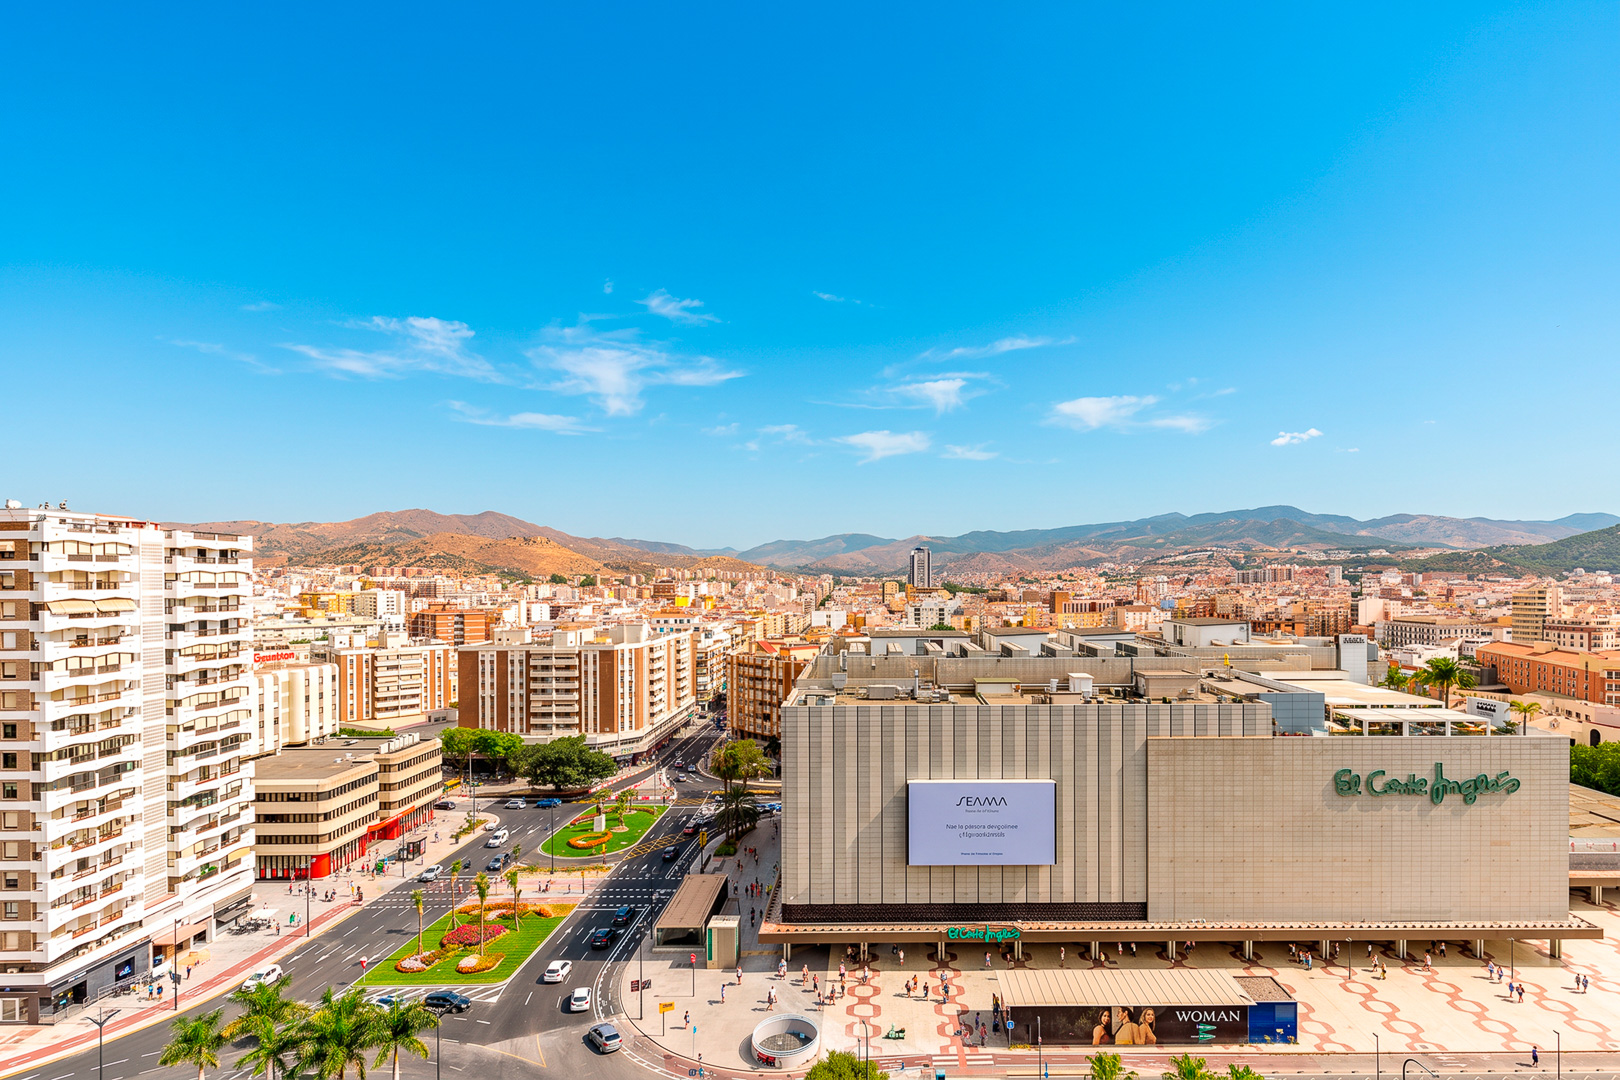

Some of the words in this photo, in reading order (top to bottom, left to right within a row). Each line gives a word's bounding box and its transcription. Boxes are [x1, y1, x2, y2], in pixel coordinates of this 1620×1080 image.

[1334, 768, 1361, 796] El
[1367, 769, 1428, 796] Corte
[948, 927, 958, 939] El
[959, 927, 984, 939] Corte
[1175, 1010, 1240, 1022] WOMAN
